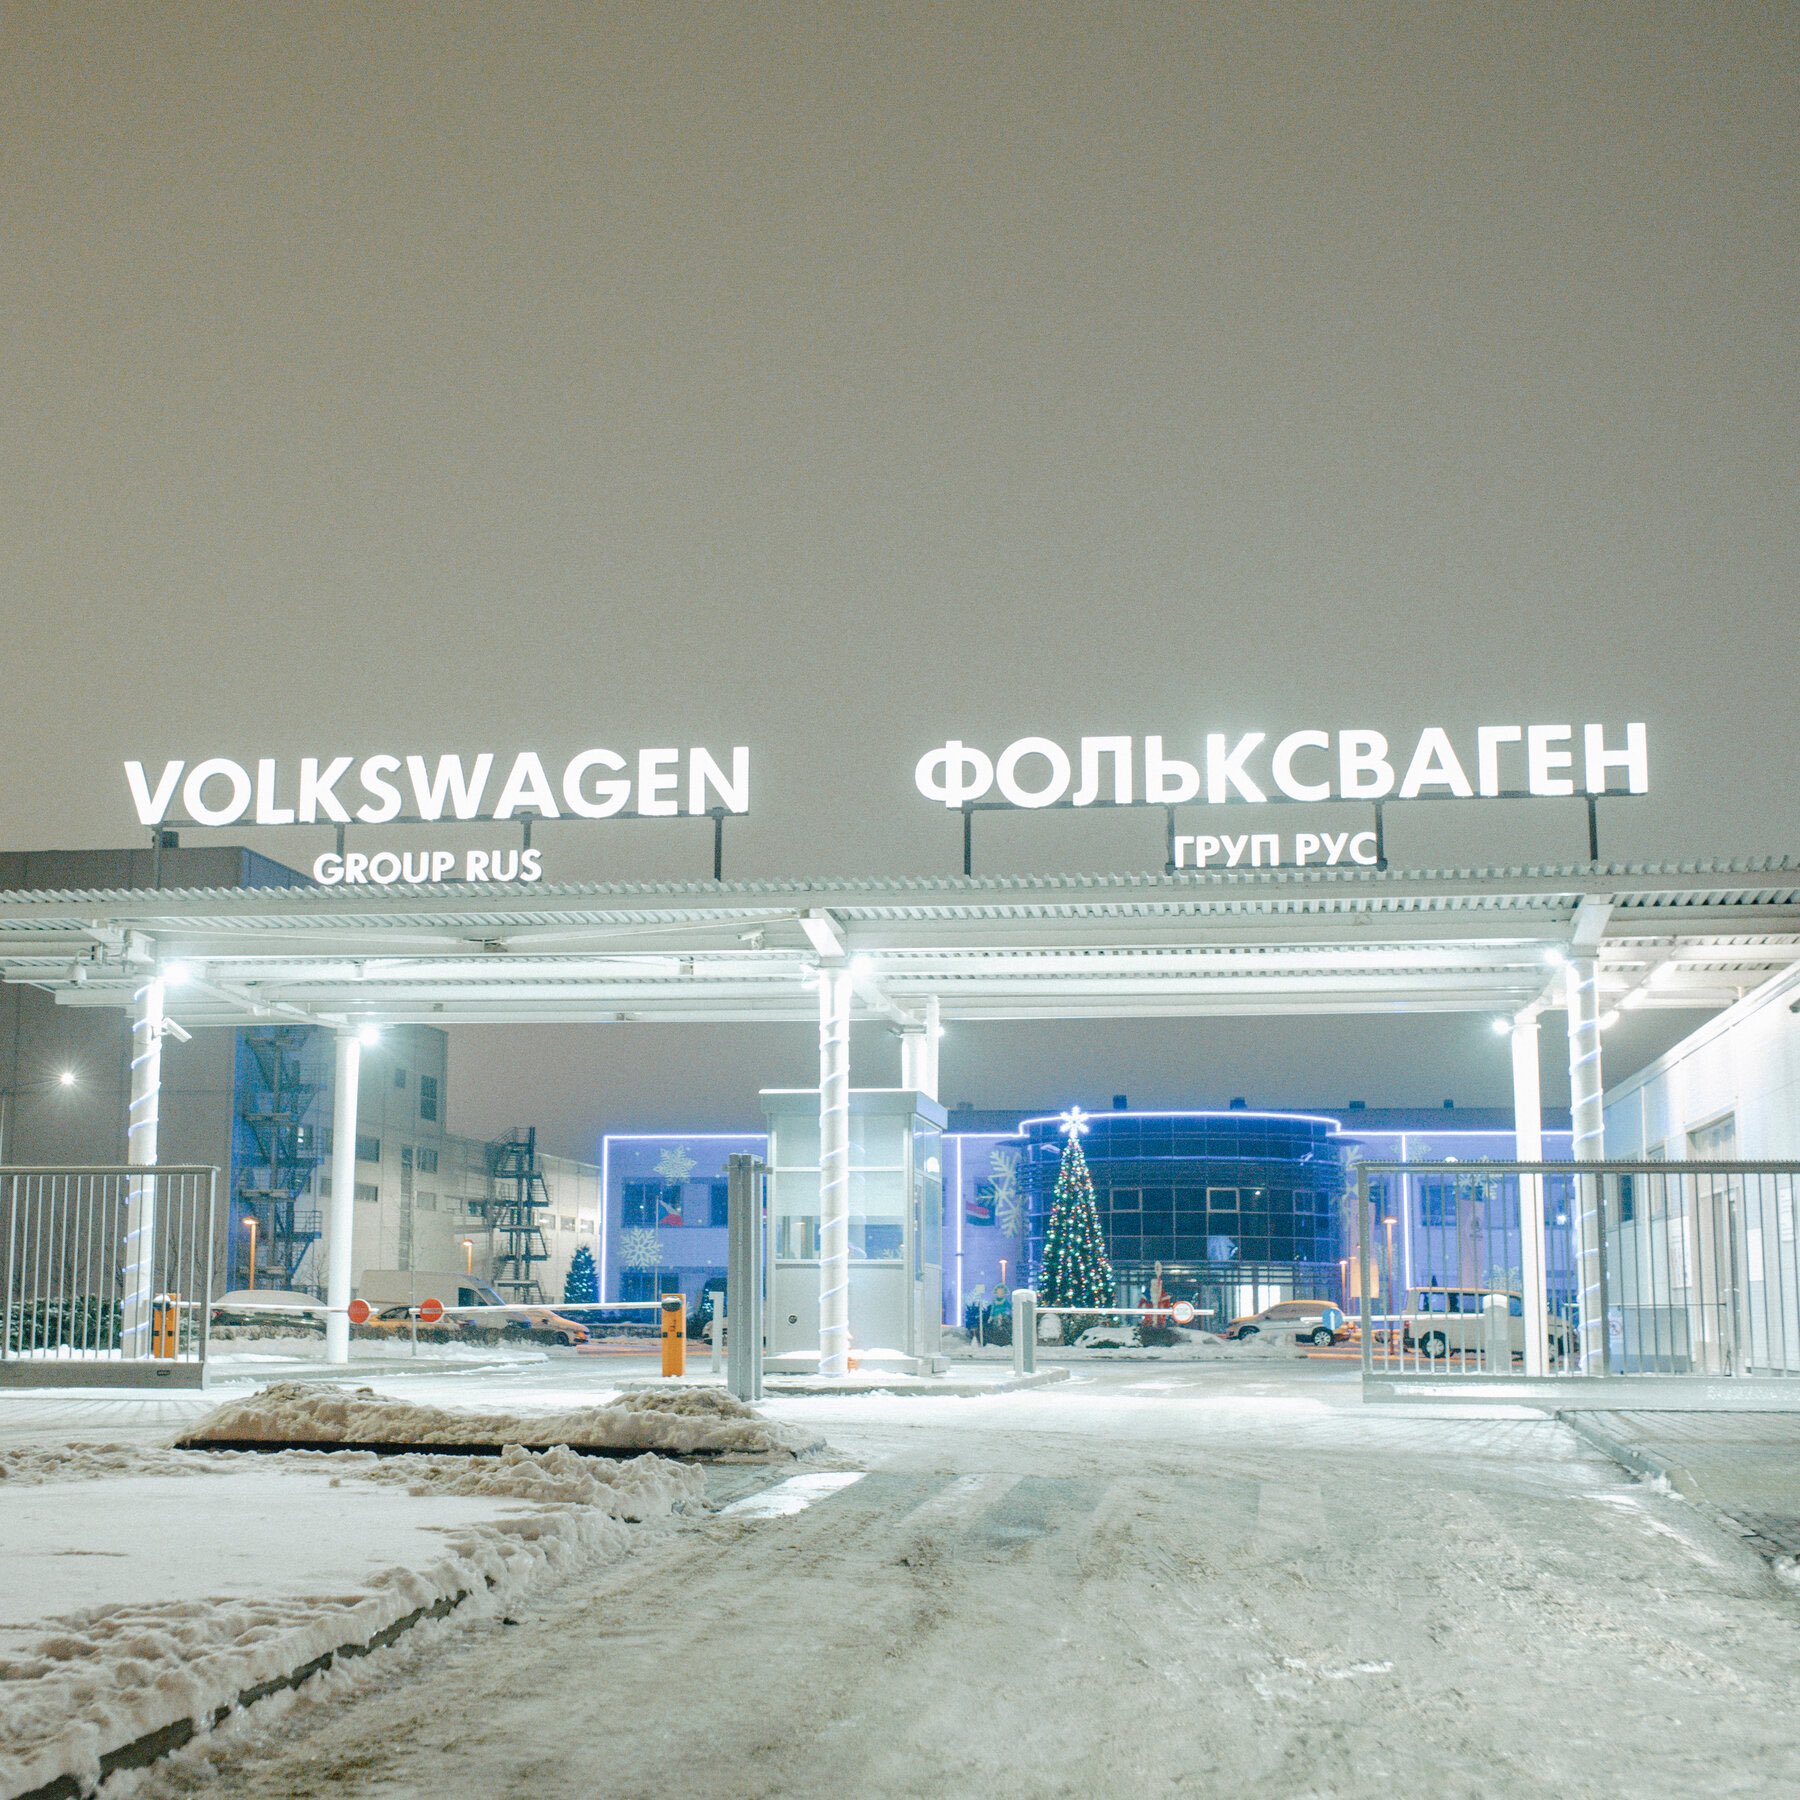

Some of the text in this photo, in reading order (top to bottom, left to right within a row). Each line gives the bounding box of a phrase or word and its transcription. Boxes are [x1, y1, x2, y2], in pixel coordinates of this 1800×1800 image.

[123, 746, 750, 827] VOLKSWAGEN
[914, 722, 1650, 809] ФОЛЬКСВАГЕН
[313, 848, 542, 885] GROUP RUS
[1174, 831, 1378, 868] ГРУП РУС
